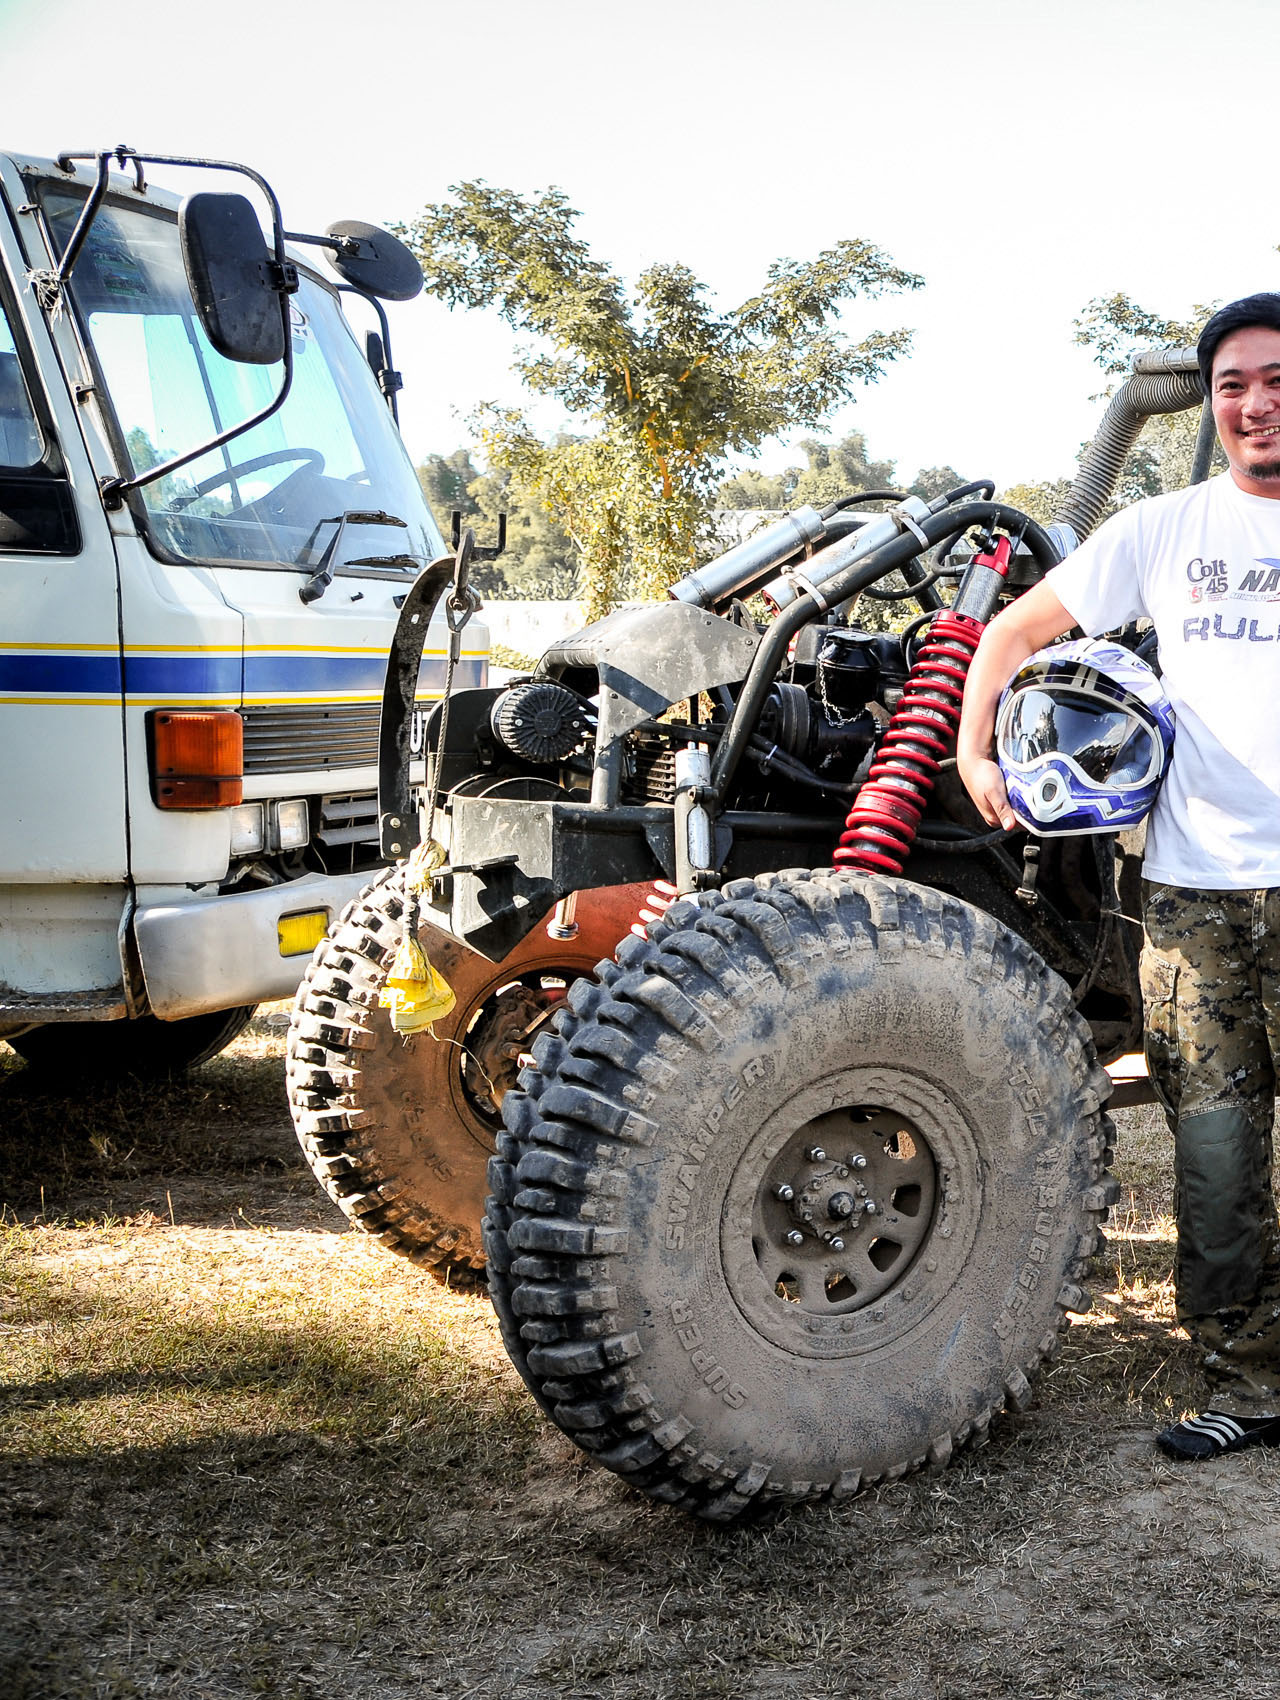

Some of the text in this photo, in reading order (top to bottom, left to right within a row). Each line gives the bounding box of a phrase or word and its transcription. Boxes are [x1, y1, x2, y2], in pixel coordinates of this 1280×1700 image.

[1187, 558, 1228, 582] Colt
[1206, 577, 1229, 594] 45
[1008, 1067, 1047, 1136] TSL
[665, 1057, 766, 1250] SWAMPER
[671, 1299, 750, 1409] SUPER
